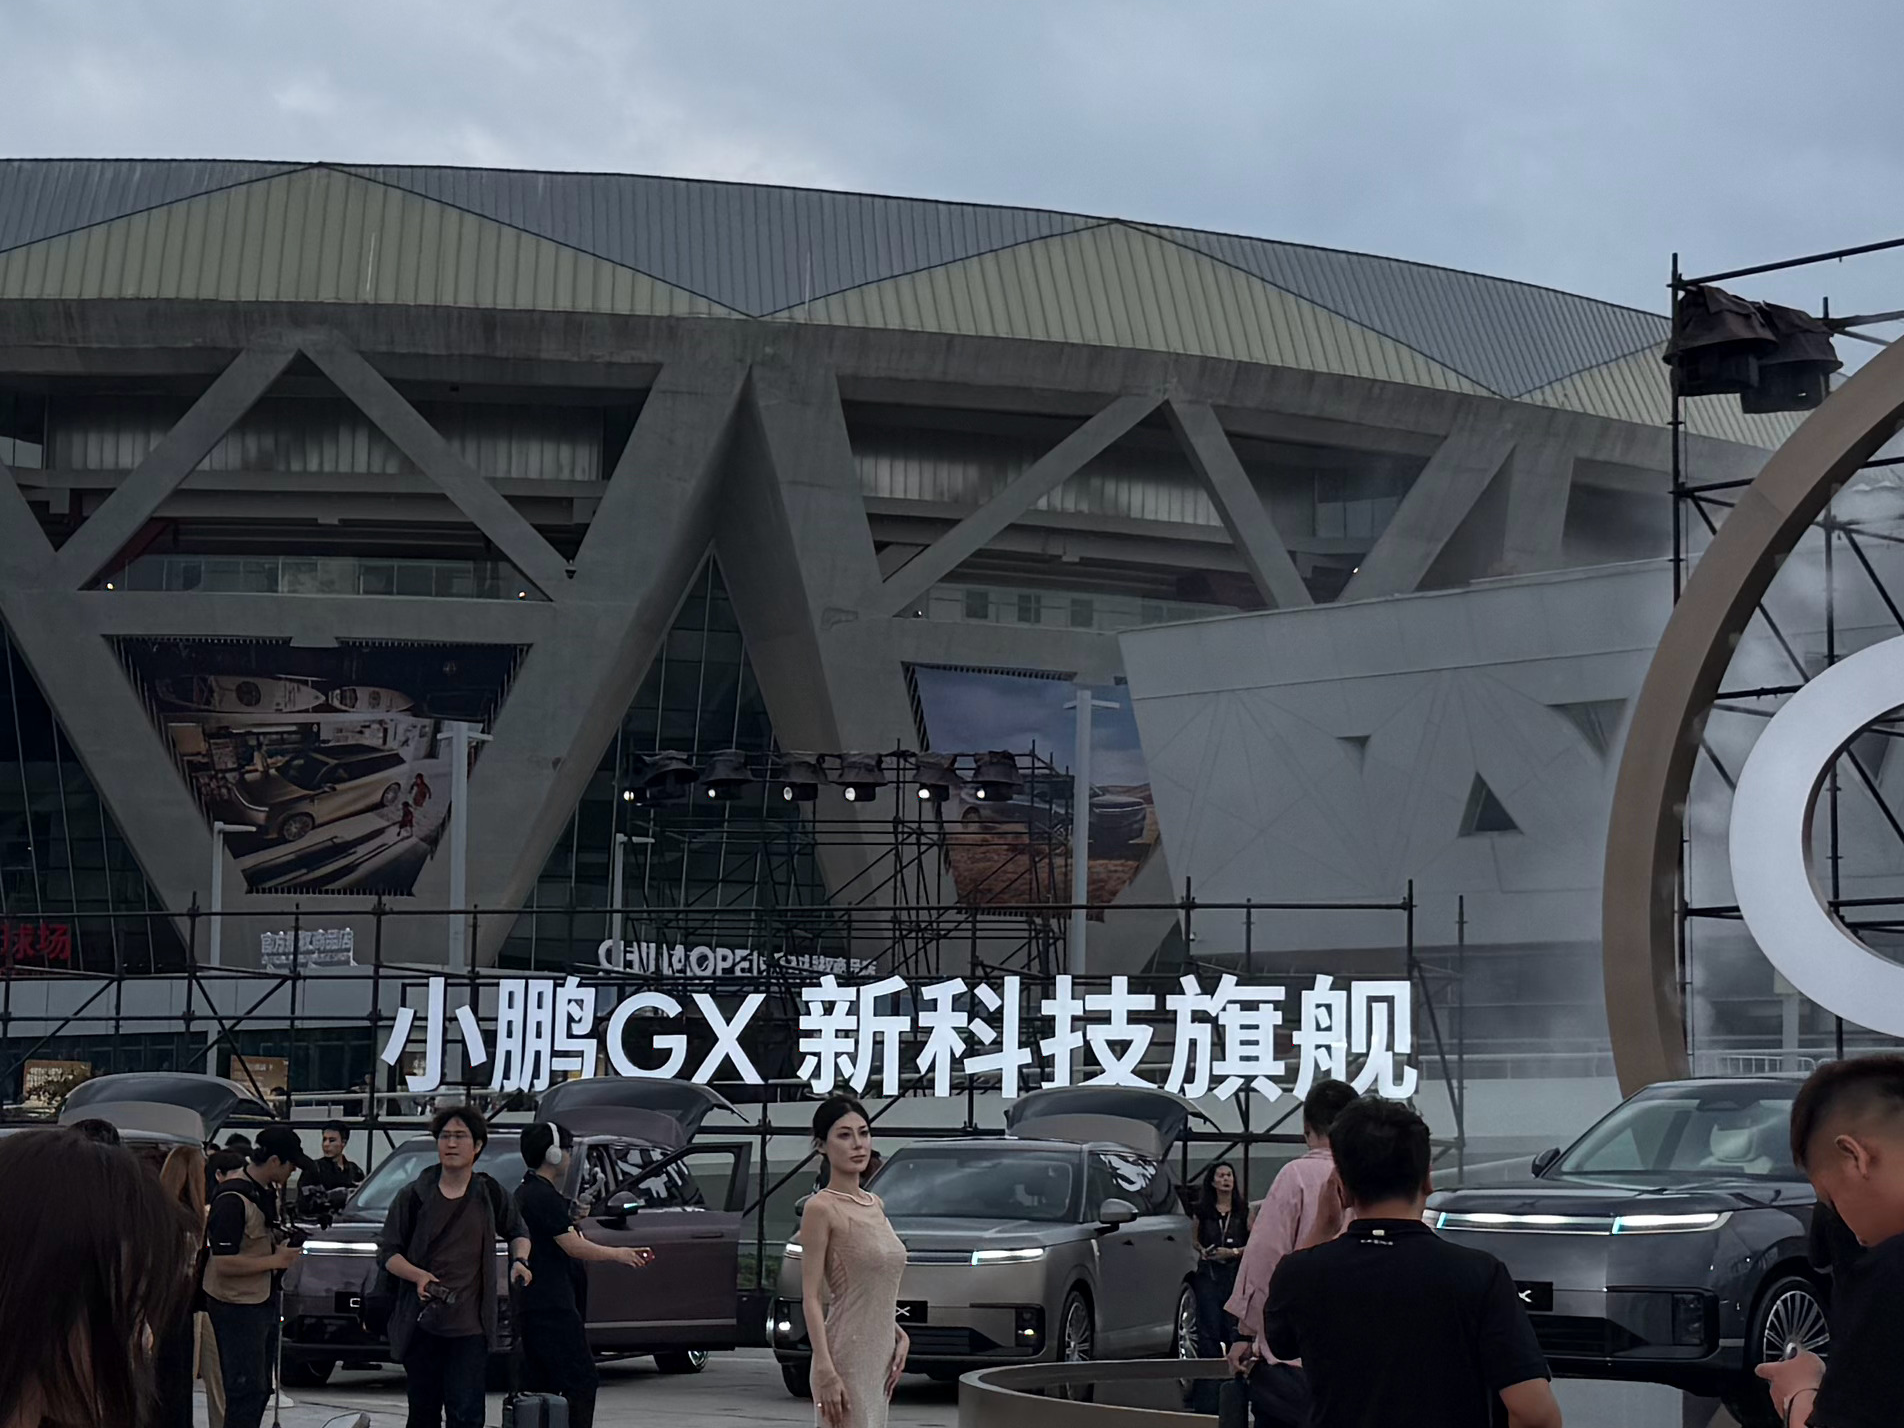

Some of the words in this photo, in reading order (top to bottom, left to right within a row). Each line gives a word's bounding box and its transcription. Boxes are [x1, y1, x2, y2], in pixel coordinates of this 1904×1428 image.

[381, 976, 765, 1093] 小鹏GX
[797, 974, 1418, 1102] 新科技旗舰
